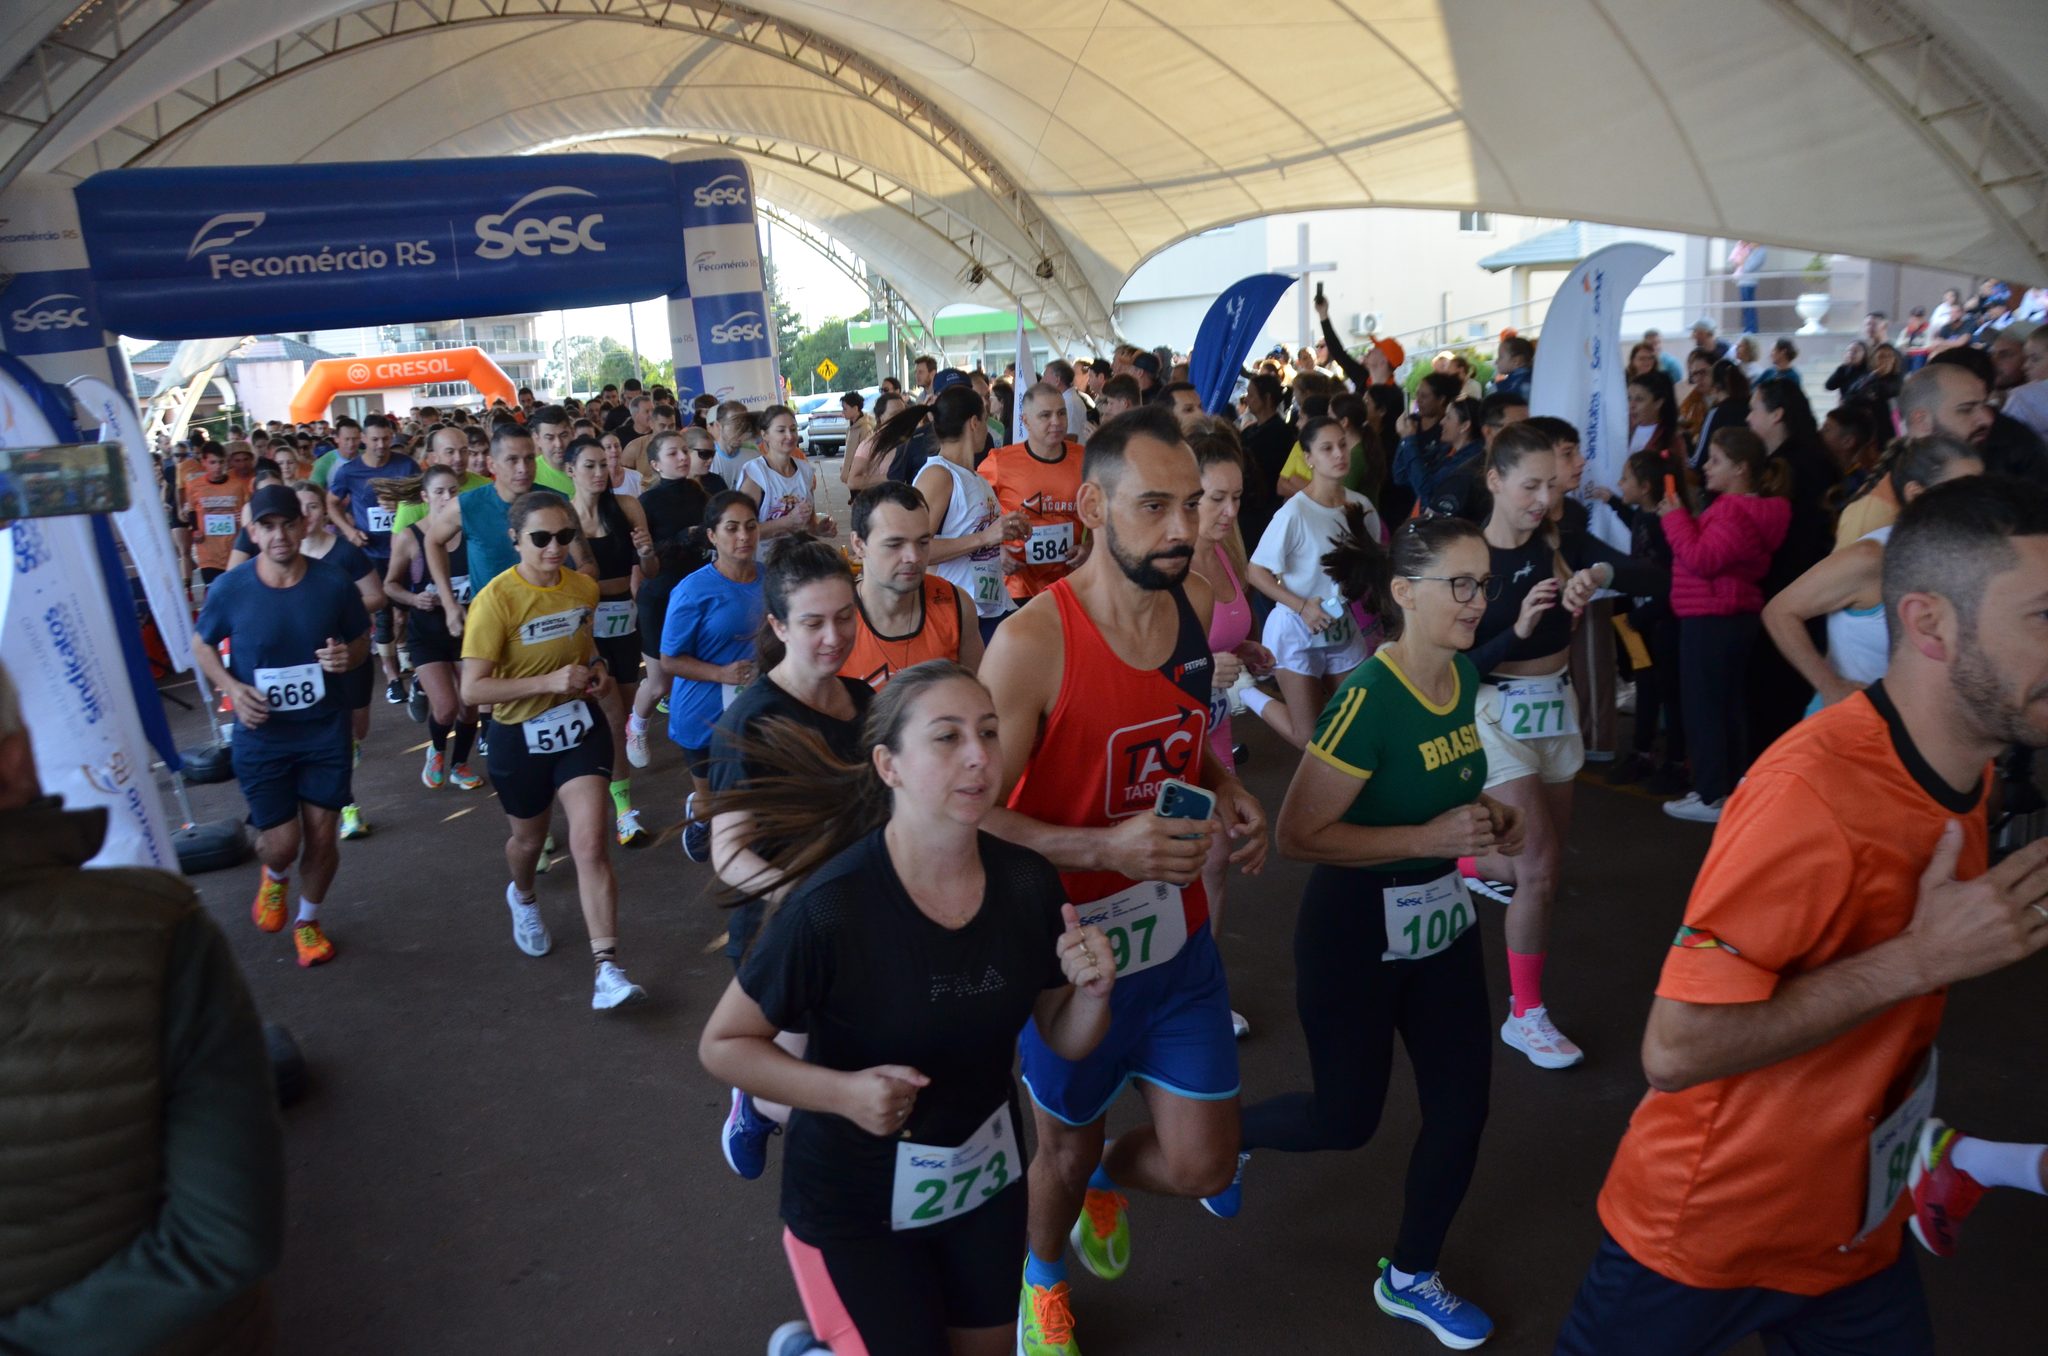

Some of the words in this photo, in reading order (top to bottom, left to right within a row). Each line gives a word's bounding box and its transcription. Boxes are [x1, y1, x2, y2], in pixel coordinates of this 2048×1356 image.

[693, 187, 747, 207] Sesc
[474, 213, 606, 260] Sesc
[209, 245, 388, 280] Fecomércio
[395, 240, 437, 267] RS
[12, 307, 89, 333] Sesc
[711, 322, 764, 345] Sesc
[376, 358, 455, 379] CRESOL
[1033, 537, 1068, 561] 584
[607, 614, 629, 634] 77
[43, 606, 98, 726] Sindicatos
[267, 681, 316, 707] 668
[1512, 700, 1565, 734] 277
[537, 719, 585, 751] 512
[1418, 723, 1482, 771] BRASI
[1124, 730, 1193, 785] TAG
[1403, 902, 1468, 955] 100
[911, 1156, 946, 1169] Sesc
[911, 1150, 1009, 1221] 273
